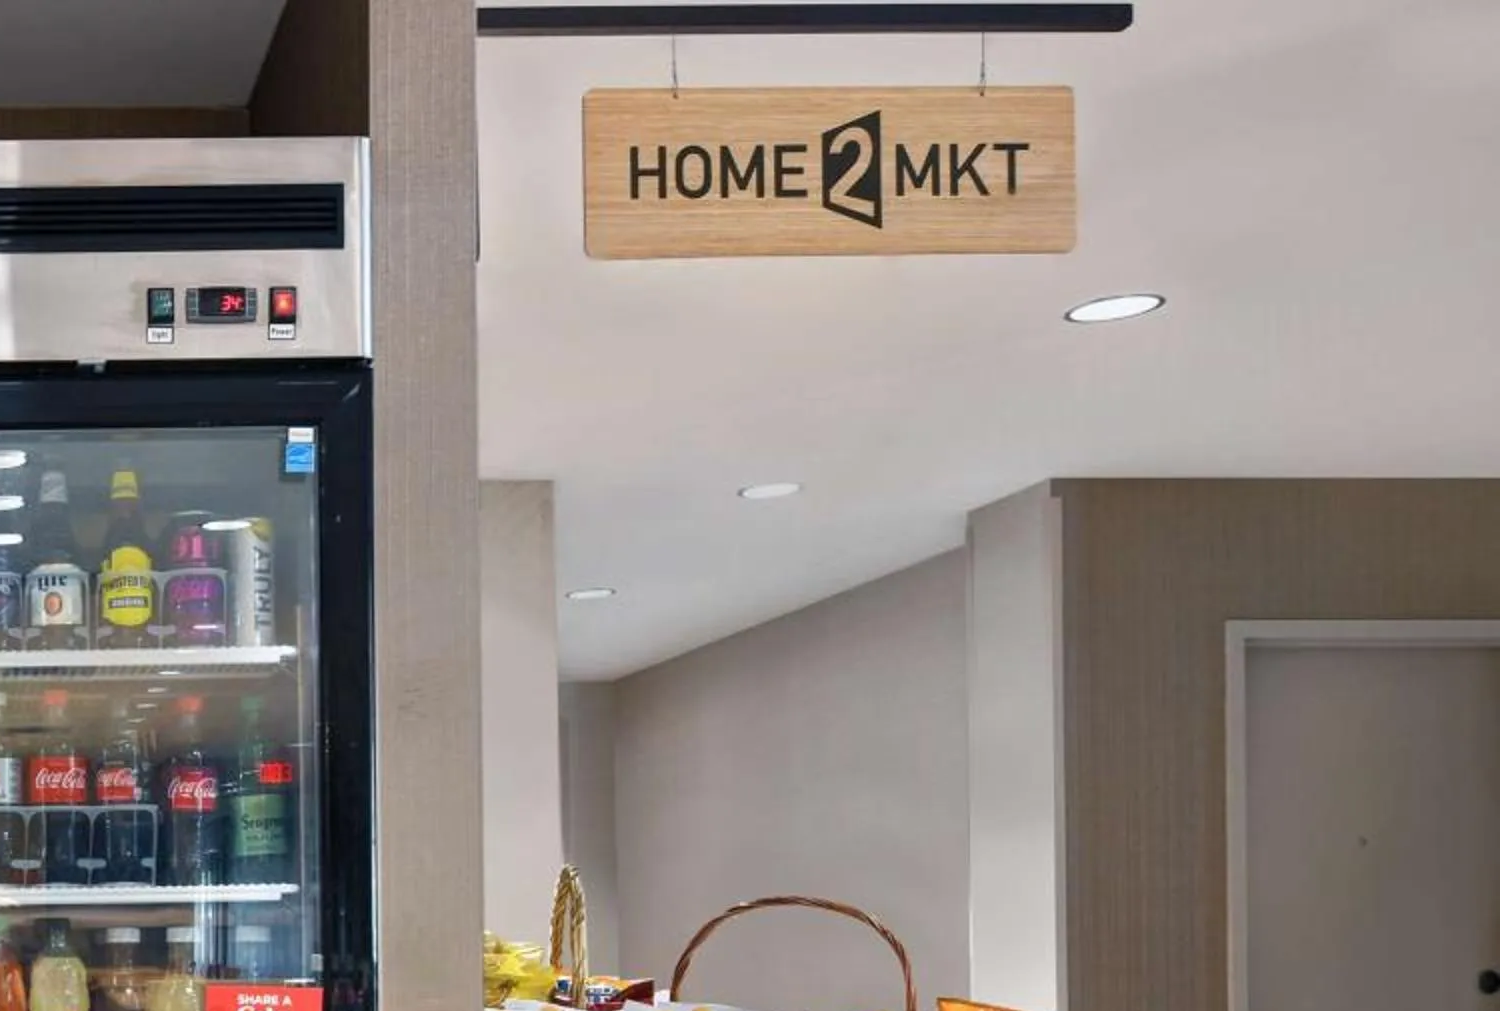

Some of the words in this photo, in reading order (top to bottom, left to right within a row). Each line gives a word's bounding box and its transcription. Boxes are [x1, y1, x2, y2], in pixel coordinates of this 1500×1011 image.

[629, 143, 809, 200] HOME
[894, 142, 1031, 198] MKT
[254, 546, 274, 626] TRULY
[237, 994, 279, 1006] SHARE
[282, 995, 293, 1006] A
